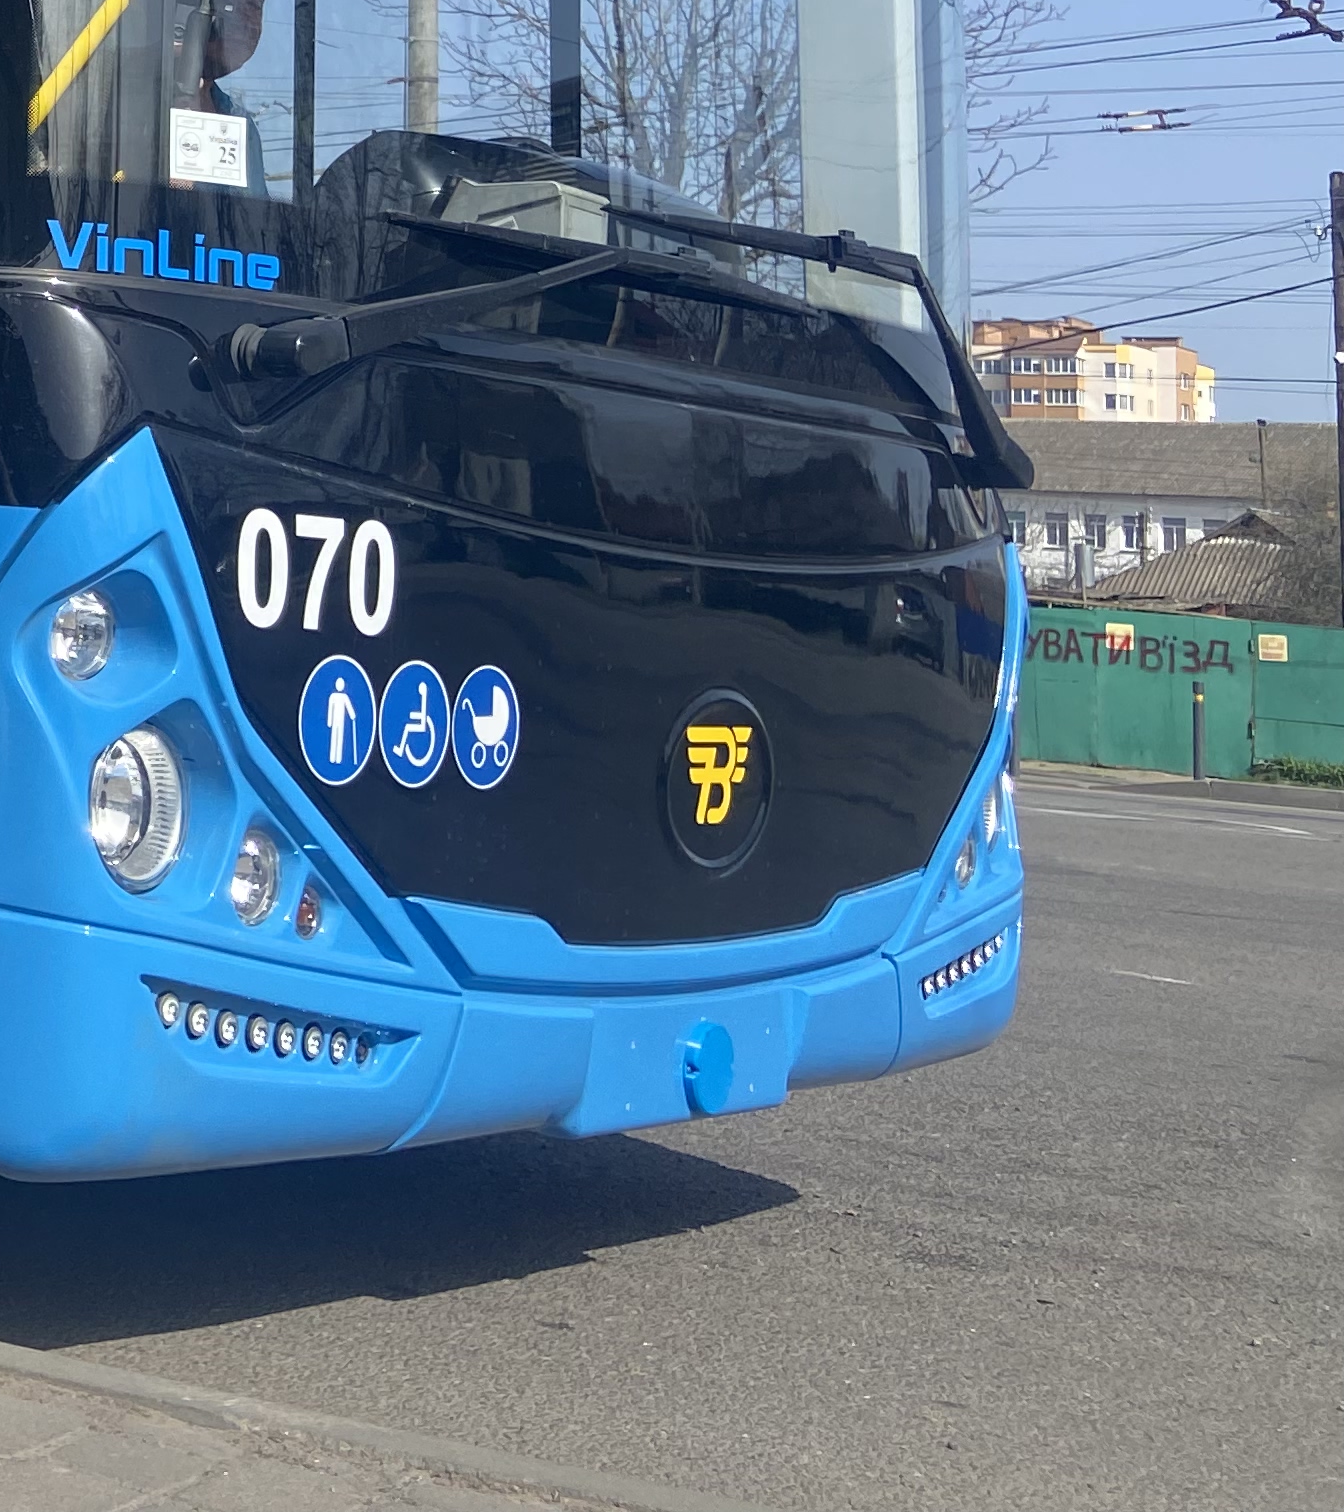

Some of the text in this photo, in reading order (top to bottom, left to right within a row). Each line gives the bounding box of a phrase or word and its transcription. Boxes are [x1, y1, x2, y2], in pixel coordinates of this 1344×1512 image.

[219, 146, 237, 165] 25
[46, 218, 280, 291] VinLine
[237, 507, 396, 637] 070
